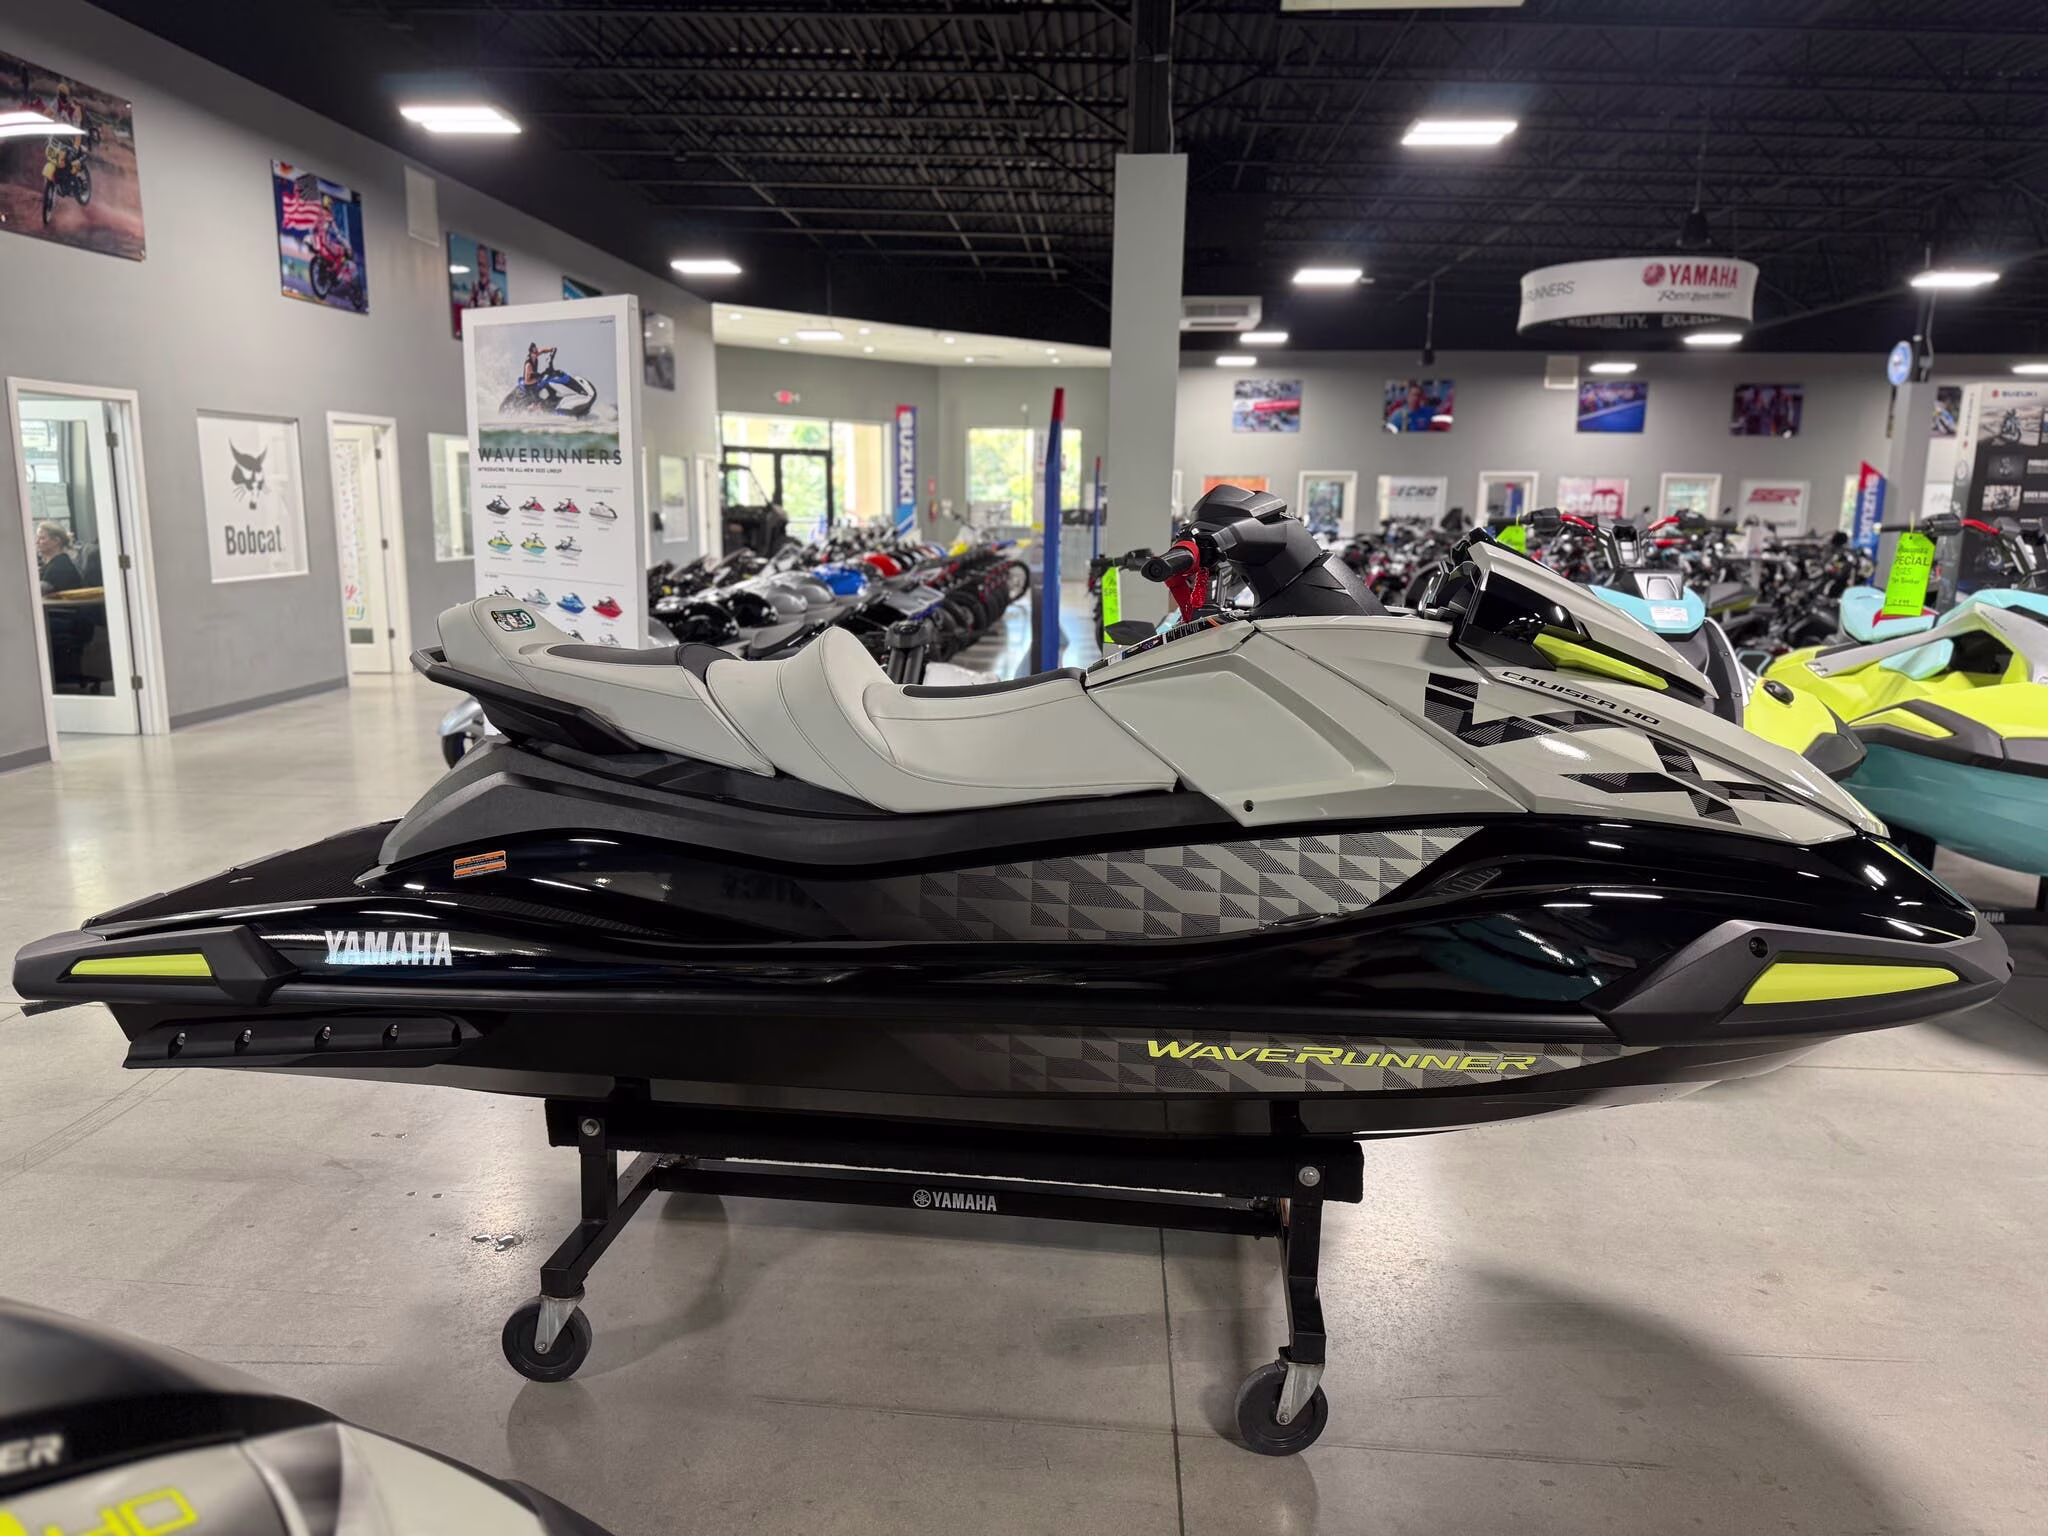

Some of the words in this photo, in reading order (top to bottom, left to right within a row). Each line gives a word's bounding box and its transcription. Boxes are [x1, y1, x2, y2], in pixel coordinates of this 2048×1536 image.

[1669, 263, 1738, 289] YAMAHA
[478, 447, 623, 465] WAVERUNNERS
[900, 412, 914, 505] SUZUKI
[1390, 485, 1438, 497] ECHO
[1565, 493, 1619, 513] SCAG
[1860, 474, 1880, 545] SUZUKI
[224, 525, 283, 555] Bobcat
[1502, 671, 1617, 710] CRUISER
[1622, 707, 1661, 726] HO
[325, 930, 453, 966] YAMAHA
[1147, 1040, 1537, 1071] WAVERUNNER
[932, 1191, 997, 1212] YAMAHA
